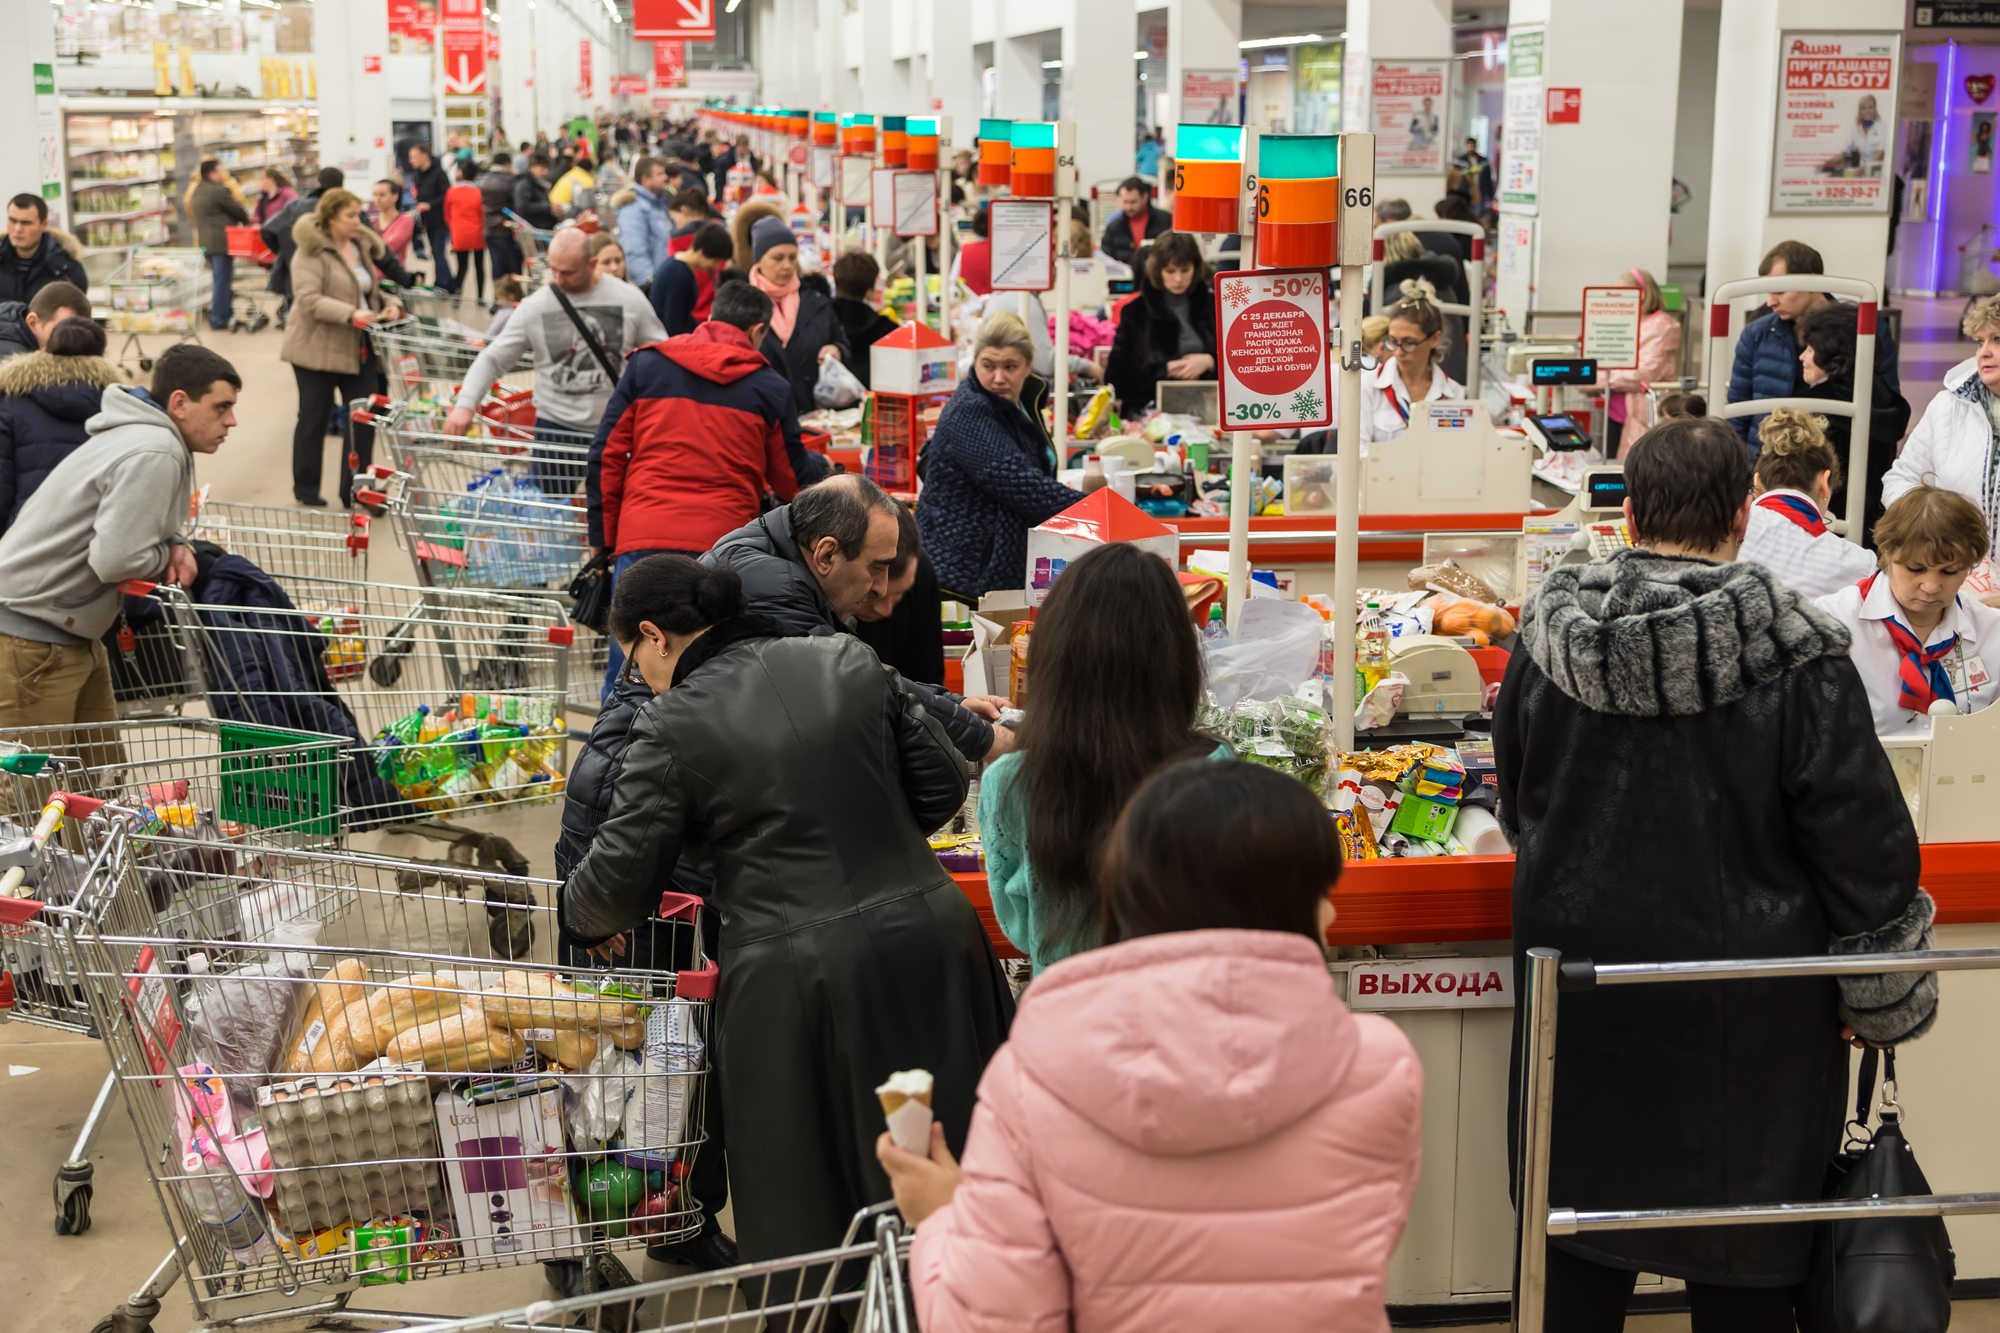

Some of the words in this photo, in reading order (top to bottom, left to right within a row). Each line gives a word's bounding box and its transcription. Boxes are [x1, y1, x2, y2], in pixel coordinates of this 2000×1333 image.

[1790, 39, 1841, 55] Ашан
[1790, 60, 1888, 72] ПРИГЛАШАЕМ
[1788, 76, 1808, 87] НА
[1811, 73, 1887, 87] РАБОТУ
[1788, 100, 1835, 109] ХОЗЯЙКА
[1059, 156, 1074, 167] 64
[1246, 175, 1257, 191] 6
[1344, 187, 1372, 208] 66
[1263, 277, 1322, 297] -50%
[1263, 311, 1304, 321] ДЕКАБРЯ
[1244, 330, 1303, 338] ГРАНДИОЗНАЯ
[1246, 338, 1302, 347] РАСПРОДАЖА
[1231, 347, 1273, 356] ЖЕНСКОЙ,
[1275, 345, 1317, 354] МУЖСКОЙ,
[1255, 355, 1293, 364] ДЕТСКОЙ
[1238, 365, 1275, 374] ОДЕЖДЫ
[1227, 402, 1281, 420] -30%
[1358, 972, 1503, 997] ВЫХОДА
